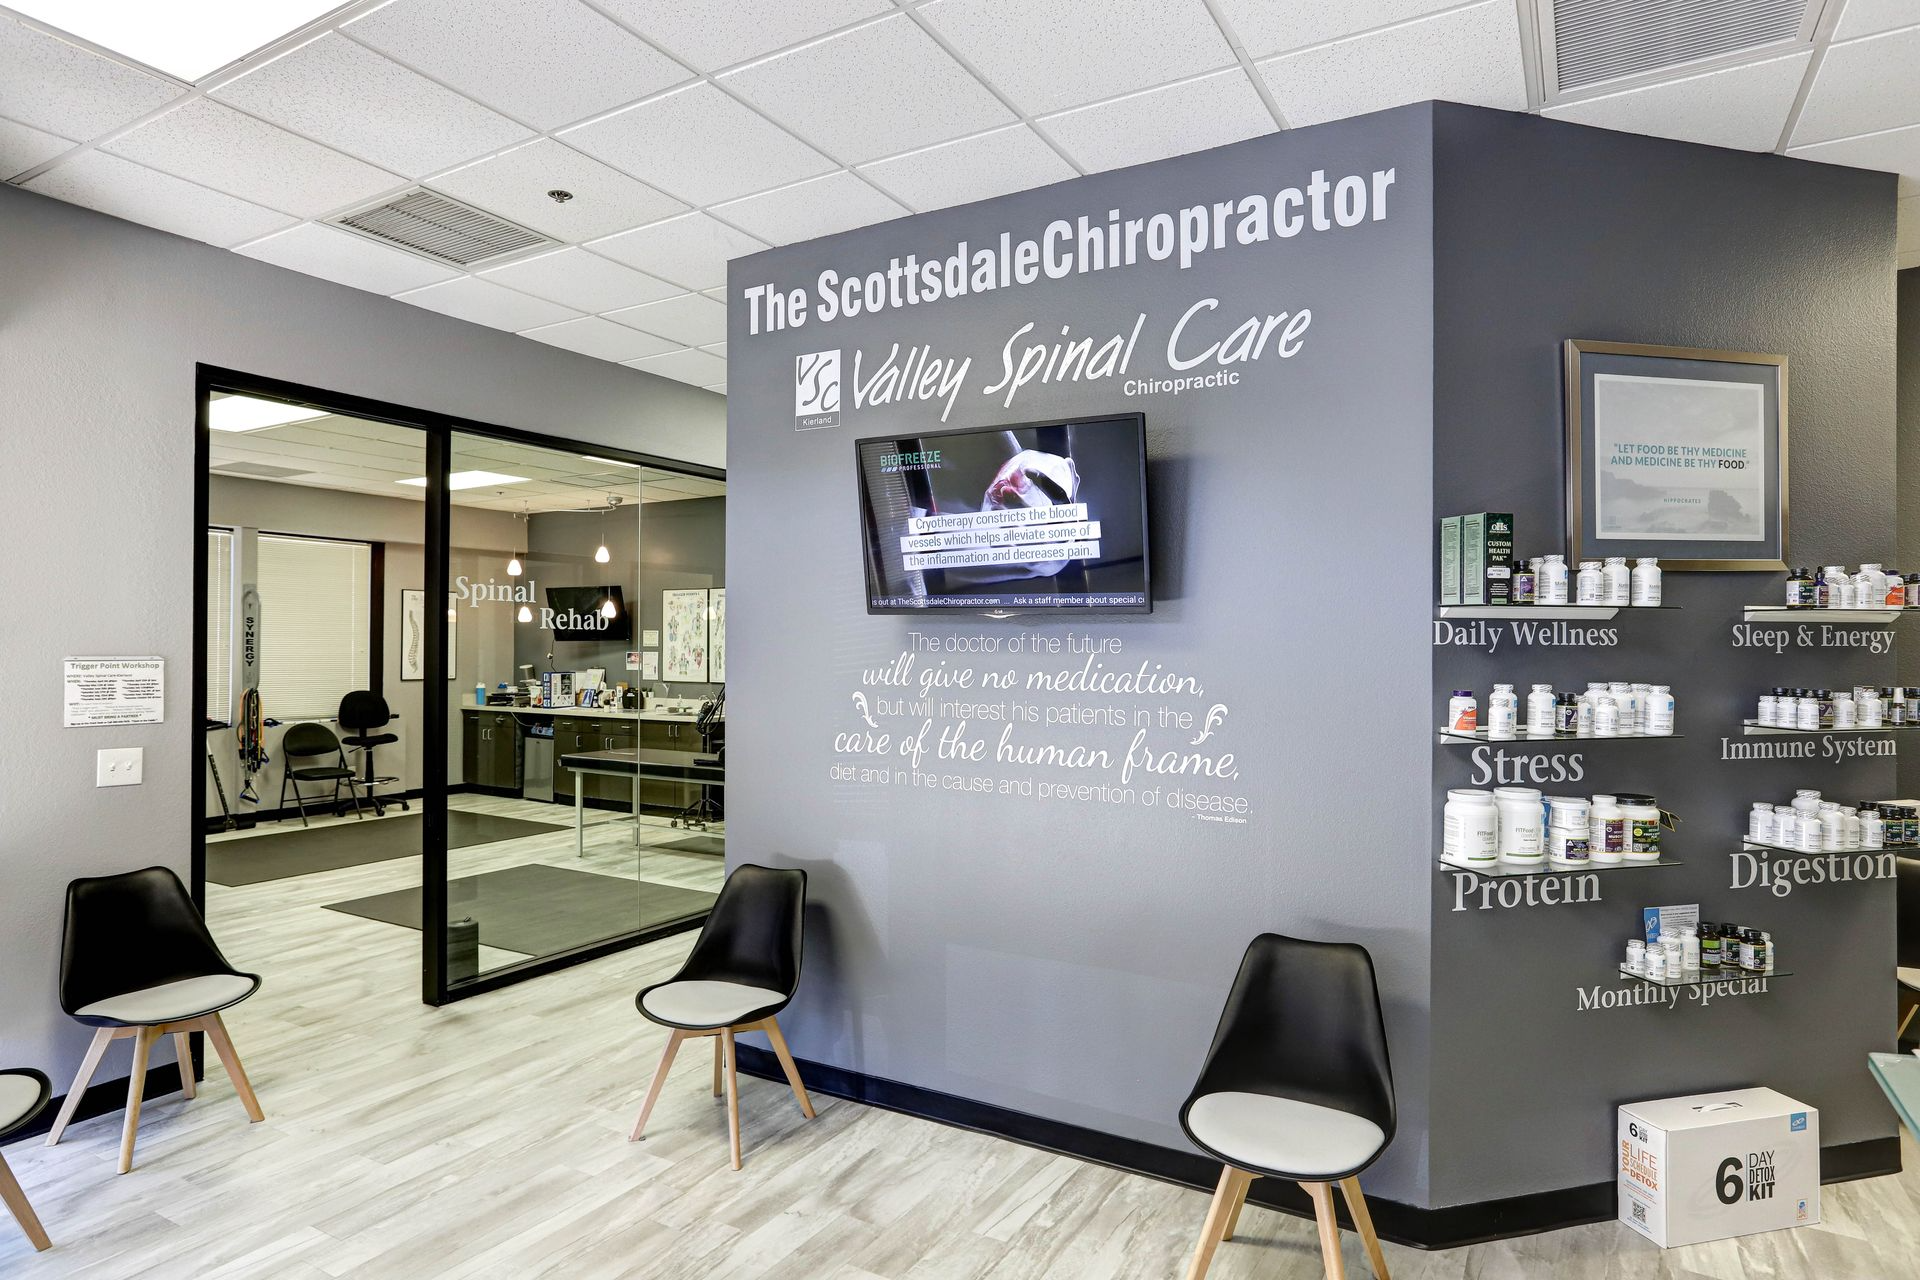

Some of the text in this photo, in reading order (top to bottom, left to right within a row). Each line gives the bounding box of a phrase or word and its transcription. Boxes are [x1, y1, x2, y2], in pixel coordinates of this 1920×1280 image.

[745, 284, 807, 335] The
[853, 298, 1312, 422] Valley Spinal Care
[1123, 370, 1240, 397] Chiropractic
[803, 416, 832, 427] Kierland
[1611, 455, 1632, 466] AND
[1635, 456, 1682, 468] MEDICINE
[1684, 459, 1695, 468] BE
[1698, 459, 1716, 469] THY
[1637, 444, 1665, 455] FOOD
[1667, 446, 1679, 456] BE
[1681, 446, 1700, 457] THY
[1702, 447, 1747, 458] MEDICINE
[899, 463, 942, 471] PROFESSIONAL
[915, 505, 1079, 532] Cryotherapy constricts the blood
[908, 524, 1091, 548] vessels which helps alleviate some of
[909, 544, 1093, 566] the inflammation and decreases pain.
[456, 575, 537, 608] Spinal
[878, 598, 889, 606] out
[890, 598, 897, 606] at
[898, 596, 1001, 607] TheScottsdaleChiropractor.com
[1013, 596, 1027, 605] Ask
[1034, 596, 1051, 604] staff
[1053, 595, 1080, 604] member
[1085, 595, 1108, 604] about
[1109, 594, 1137, 606] special
[539, 607, 609, 631] Rehab
[245, 616, 255, 667] SYNERGY
[908, 632, 1122, 654] The doctor of the future
[1433, 621, 1618, 653] Daily Wellness
[1732, 624, 1896, 654] Sleep & Energy
[70, 662, 98, 670] Trigger
[862, 651, 1204, 698] will give no medication,
[877, 696, 1193, 729] but will interest his patients in the
[834, 719, 1240, 785] care of the human frame,
[1720, 735, 1897, 764] Immune System
[1471, 745, 1584, 786] Stress
[829, 763, 1254, 815] diet and in the cause and prevention of disease.
[1197, 814, 1223, 822] Thomas
[1224, 816, 1247, 824] Edison
[1729, 851, 1897, 897] Digestion
[1452, 872, 1602, 912] Protein
[1577, 984, 1680, 1011] Monthly
[1689, 976, 1768, 1006] Special
[1629, 1122, 1638, 1138] 6
[1621, 1139, 1630, 1173] YOUR
[1630, 1143, 1657, 1170] LIFE
[1630, 1157, 1657, 1181] SCHEDULE
[1749, 1150, 1775, 1168] DAY
[1630, 1169, 1658, 1191] DETOX
[1716, 1157, 1744, 1205] 6
[1749, 1165, 1775, 1184] DETOX
[1749, 1182, 1775, 1201] KIT
